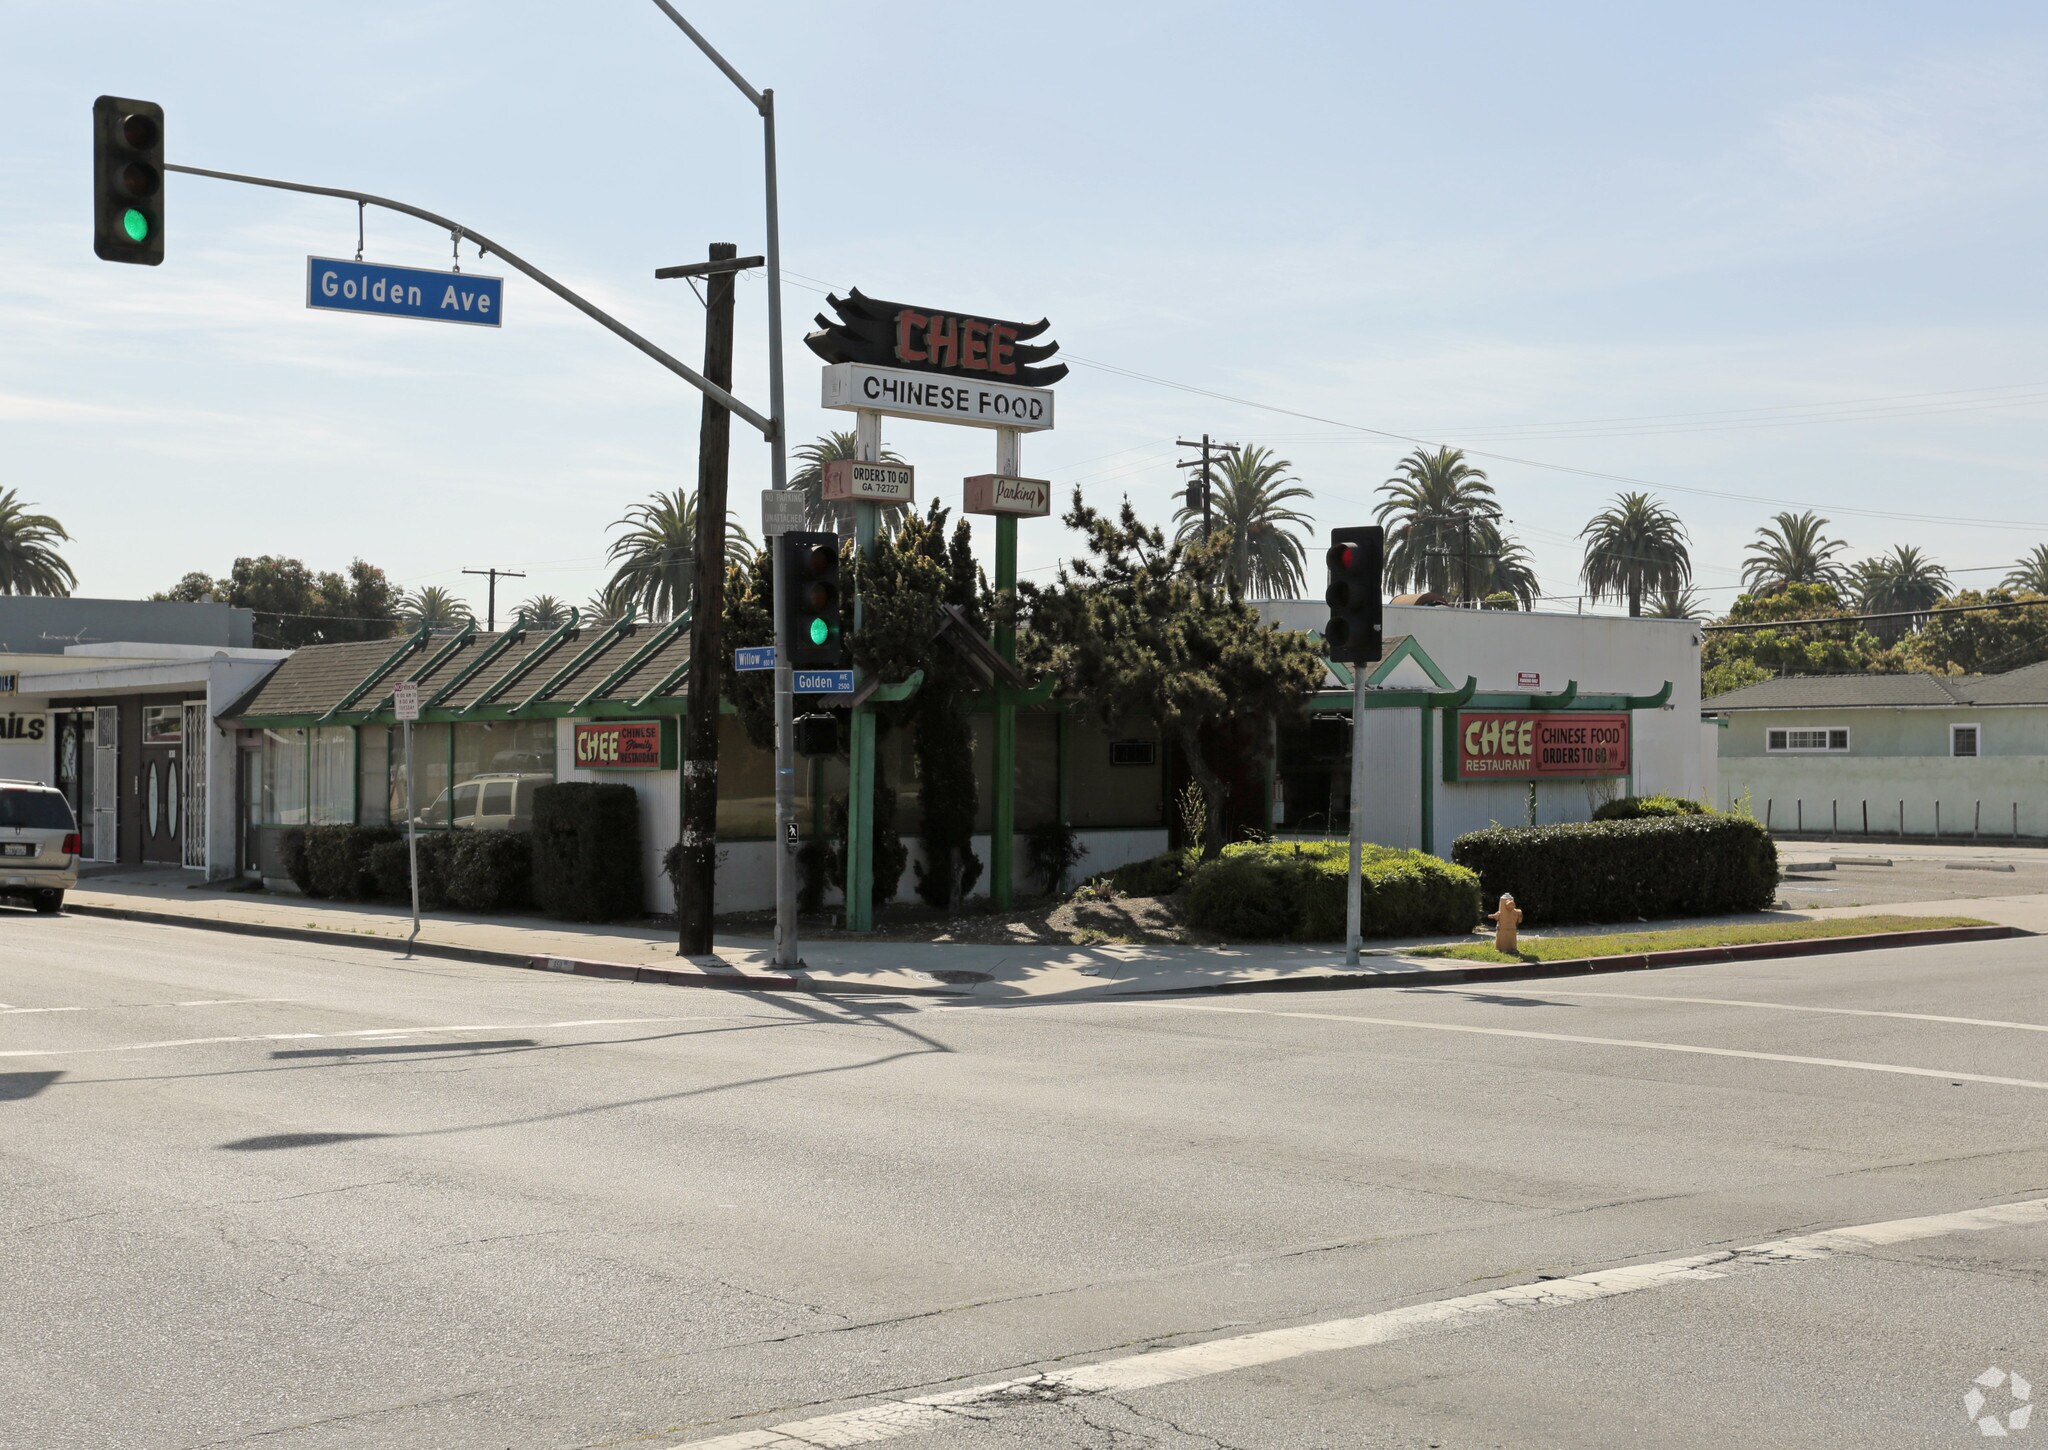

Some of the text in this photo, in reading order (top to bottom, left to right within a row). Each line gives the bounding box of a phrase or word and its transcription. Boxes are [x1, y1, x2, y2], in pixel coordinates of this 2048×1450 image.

[321, 271, 491, 313] Golden Ave
[894, 309, 1019, 375] CHEE
[863, 376, 969, 411] CHINESE
[979, 392, 1044, 420] FOOD
[853, 467, 909, 484] ORDERS TO GO
[876, 483, 899, 494] 7-2727
[995, 480, 1036, 509] Parking
[764, 493, 803, 503] NO PARKING
[779, 503, 788, 513] OF
[764, 513, 803, 523] UNATTACHED
[738, 653, 761, 666] Willow
[799, 675, 833, 688] Golden
[622, 728, 656, 738] CHINESE
[1465, 719, 1534, 756] CHEE
[1541, 728, 1620, 744] CHINESE FOOD
[578, 731, 619, 761] CHEE
[625, 740, 653, 751] Family
[620, 752, 659, 763] RESTAURANT
[1542, 747, 1607, 764] ORDERS TO GO
[1466, 759, 1531, 771] RESTAURANT
